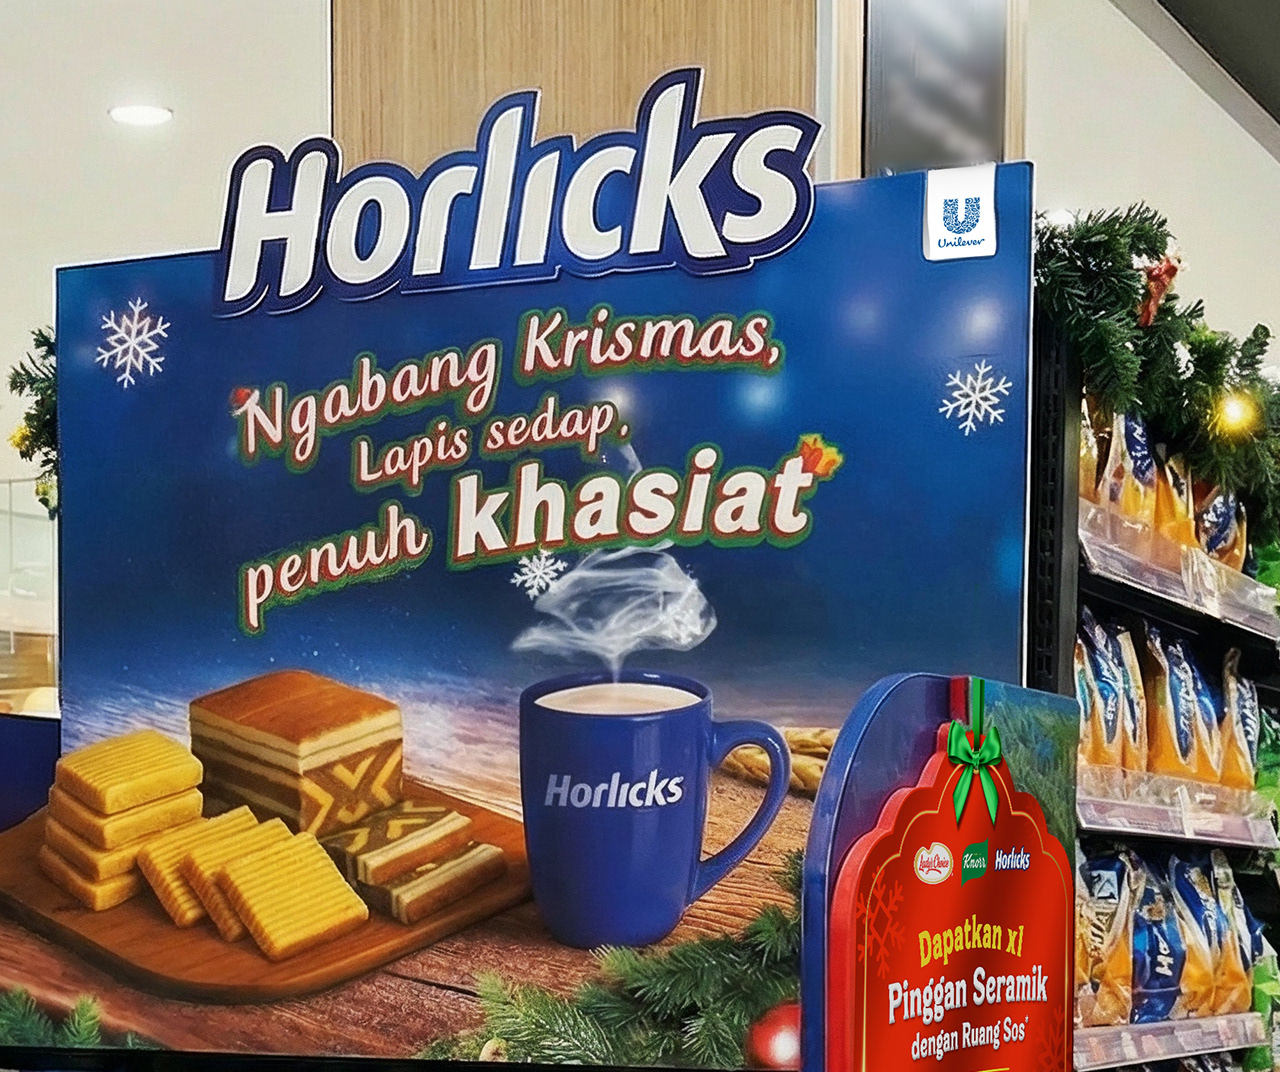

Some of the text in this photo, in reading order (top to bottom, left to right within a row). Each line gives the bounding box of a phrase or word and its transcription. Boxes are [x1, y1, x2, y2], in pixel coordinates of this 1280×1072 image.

[223, 68, 817, 303] Horlicks
[938, 237, 985, 248] Unilever
[240, 309, 780, 461] Ngabang Krismas,
[353, 402, 629, 492] Lapis sedap.
[244, 447, 814, 630] penuh khasiat
[543, 768, 685, 809] Horlicks
[962, 853, 987, 869] Knorr
[995, 845, 1031, 871] Horlicks
[918, 914, 1002, 968] Dapatkan
[888, 964, 1049, 1025] Pinggan Seramik
[911, 1029, 959, 1061] dengan
[962, 1020, 1001, 1050] Ruang
